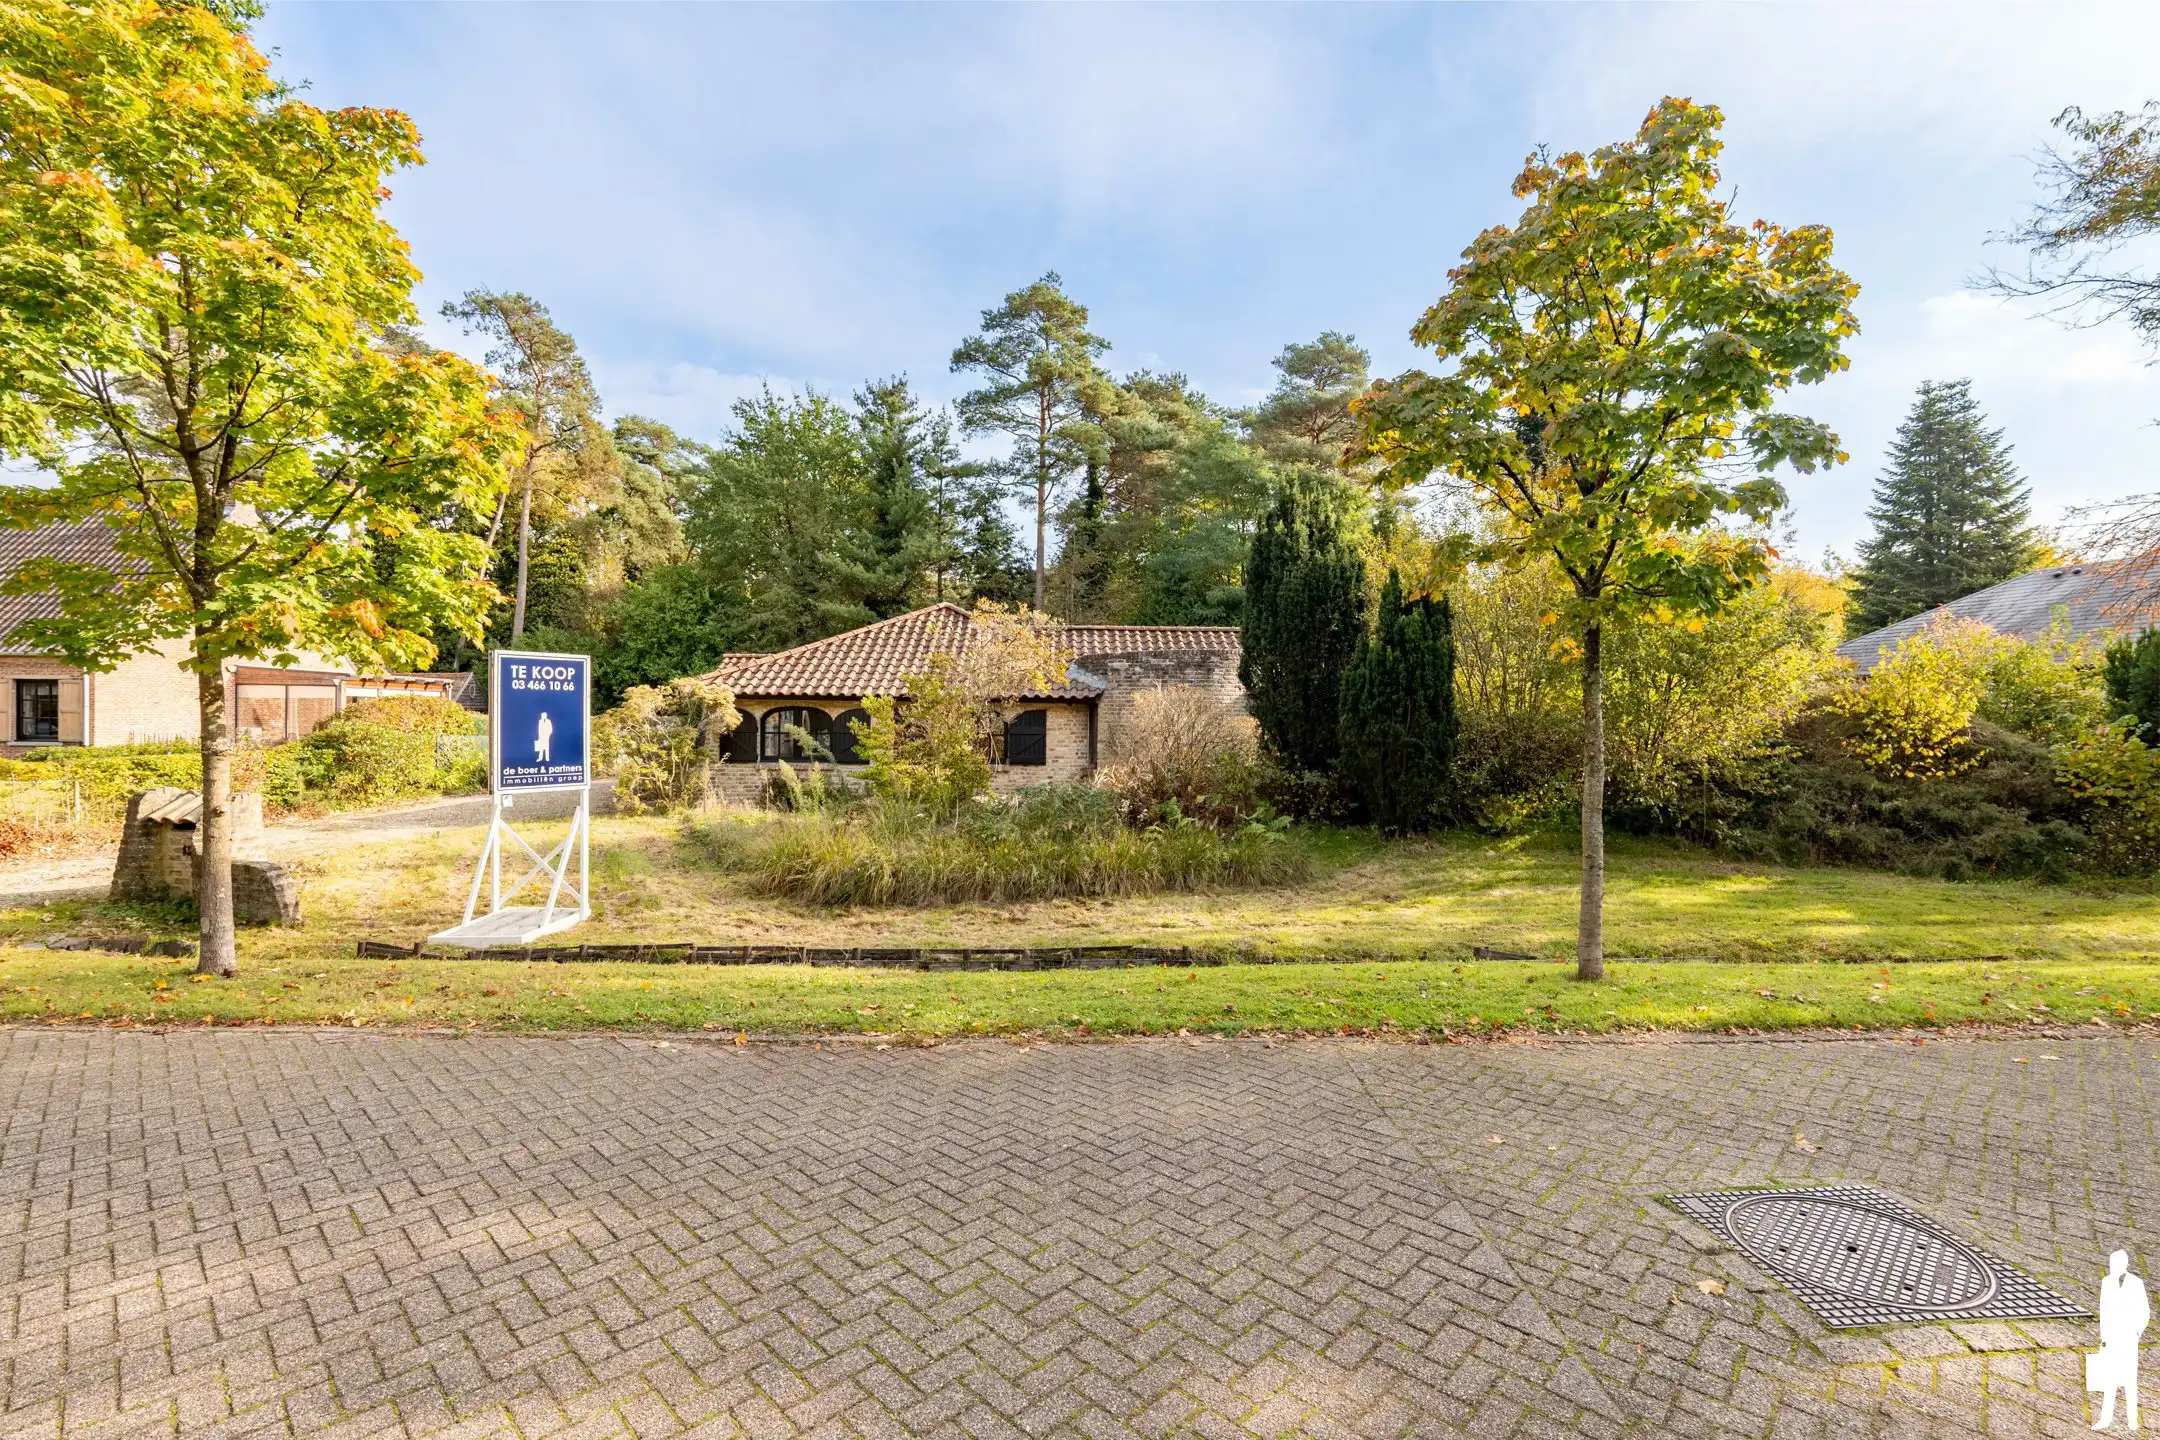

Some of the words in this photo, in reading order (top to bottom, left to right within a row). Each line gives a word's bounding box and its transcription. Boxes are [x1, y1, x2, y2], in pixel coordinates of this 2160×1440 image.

[511, 665, 527, 679] TE
[532, 666, 576, 680] KOOP
[512, 680, 525, 690] 03
[527, 681, 546, 690] 466
[549, 681, 561, 691] 10
[563, 682, 575, 691] 66
[503, 767, 515, 775] de
[517, 767, 538, 775] boer
[549, 765, 582, 774] partners
